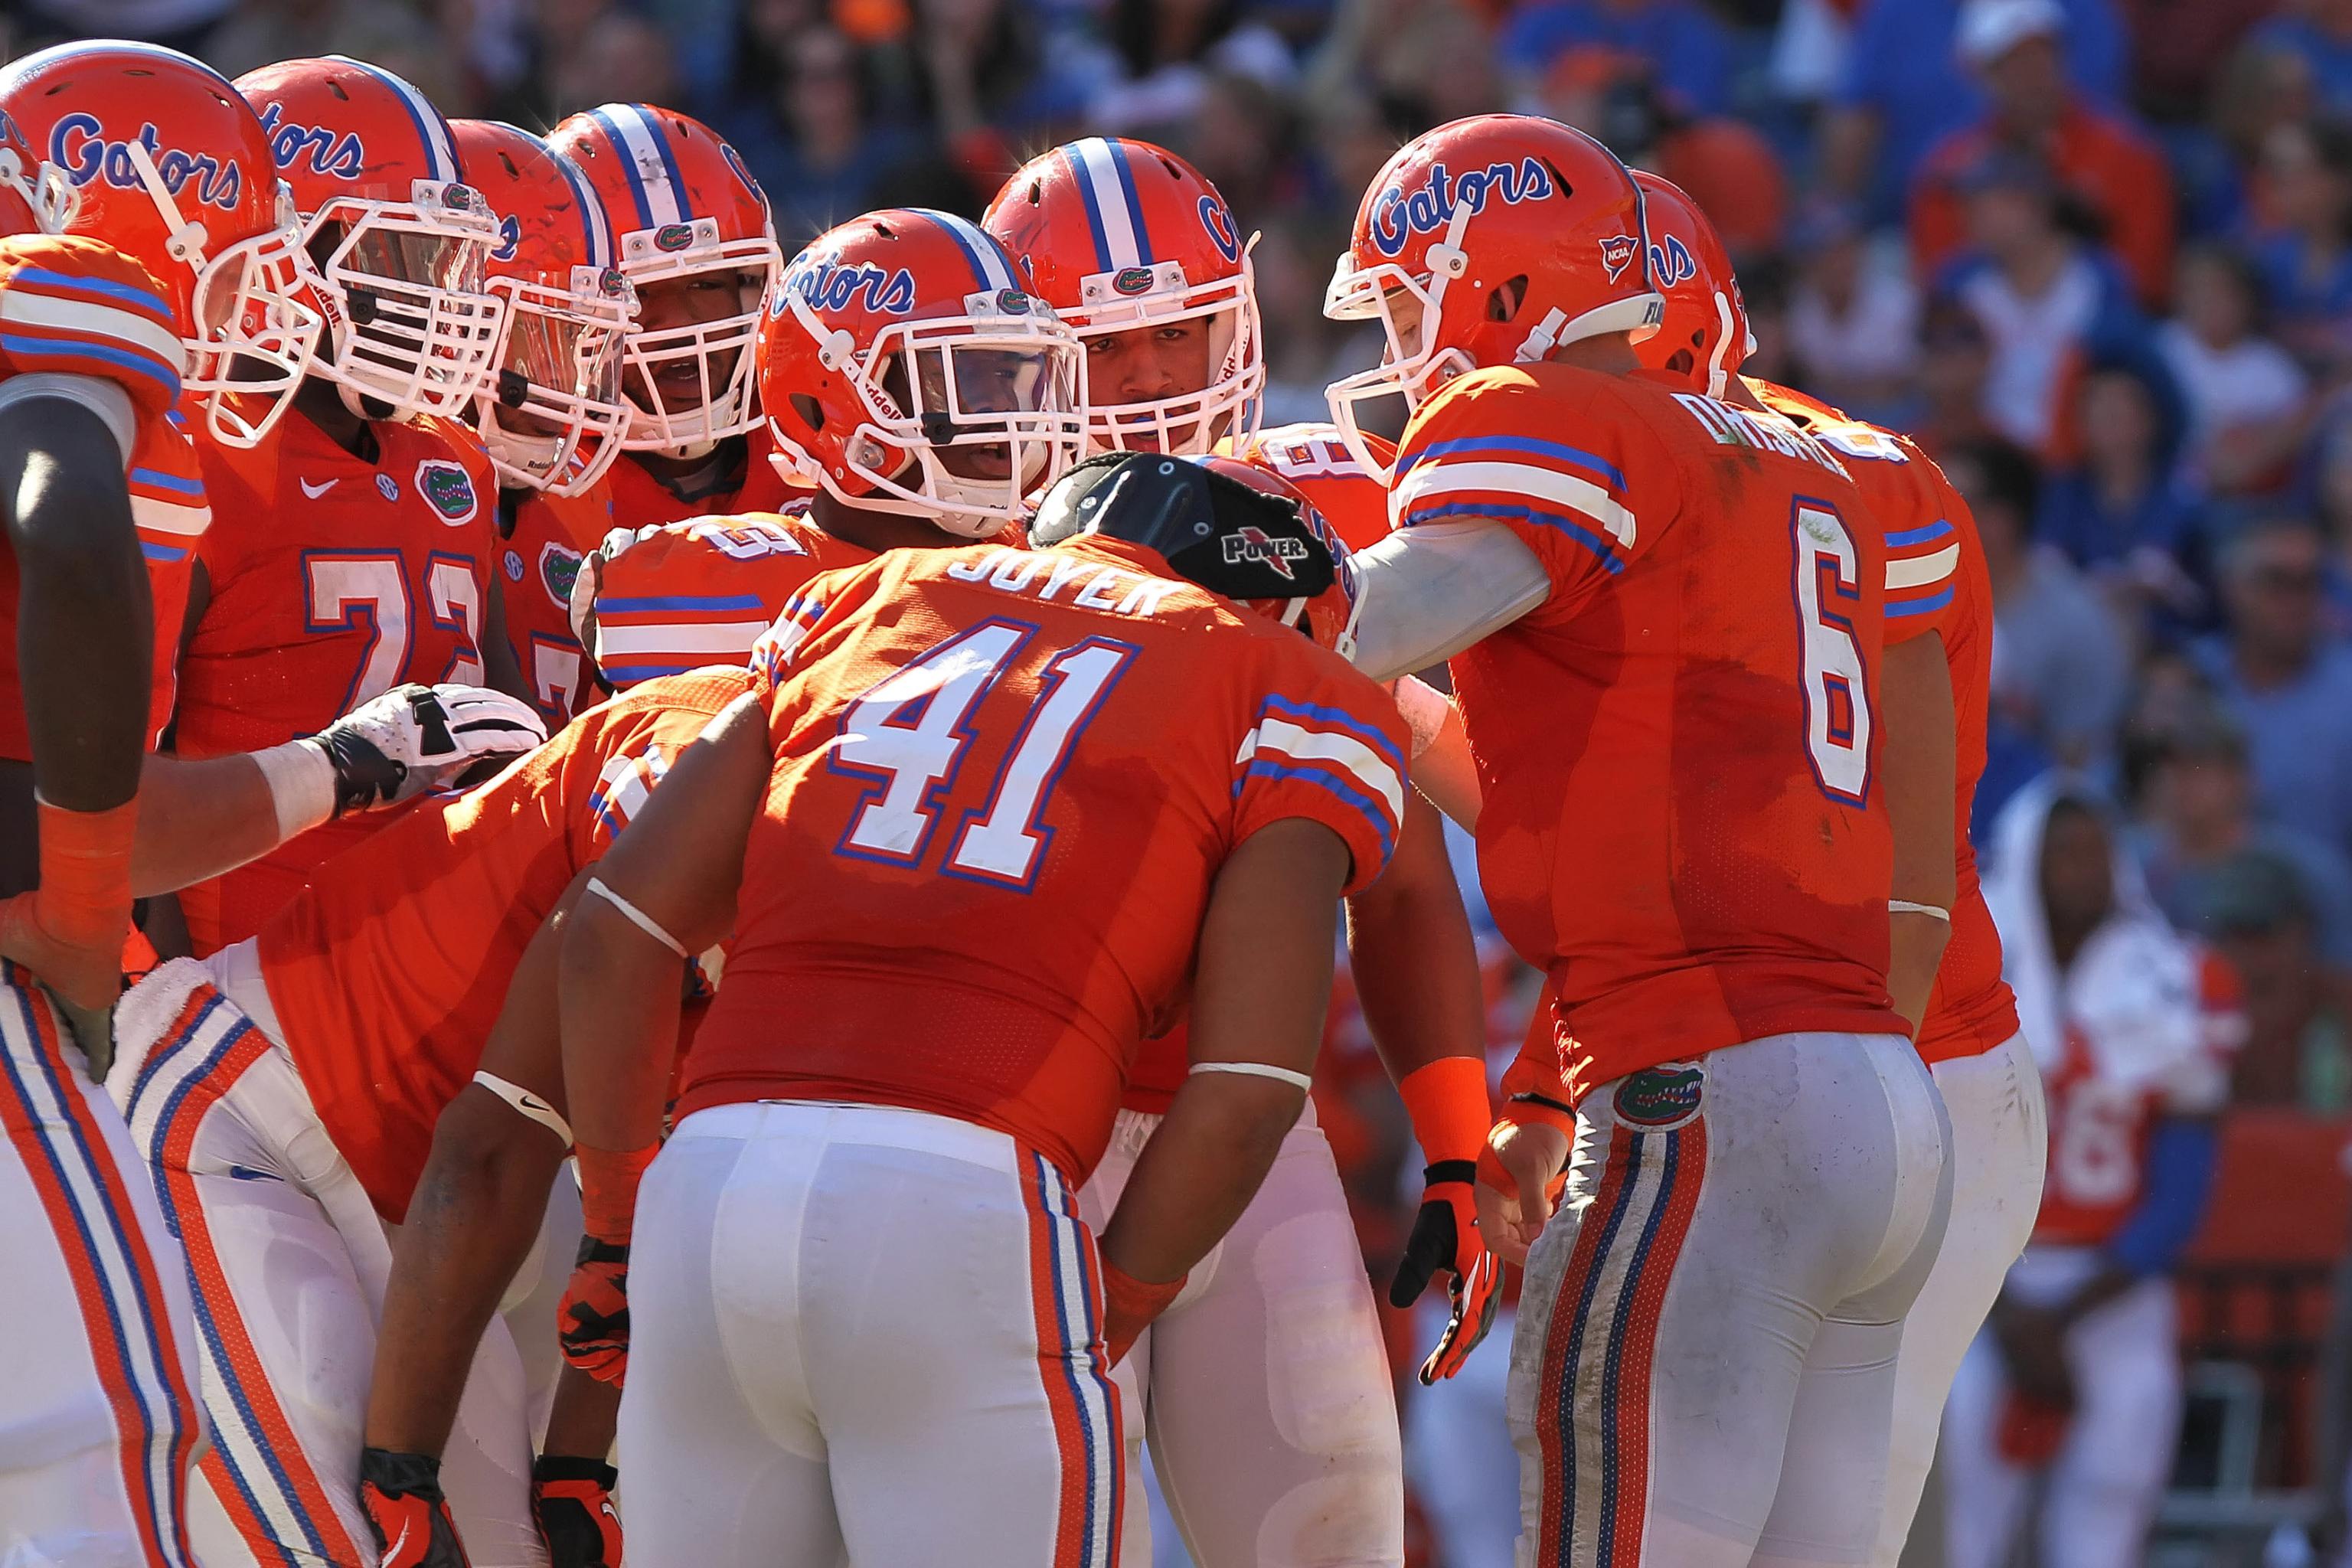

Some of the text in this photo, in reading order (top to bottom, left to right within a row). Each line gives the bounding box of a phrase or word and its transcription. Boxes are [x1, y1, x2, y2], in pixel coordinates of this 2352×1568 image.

[49, 113, 241, 211] Gators
[1373, 156, 1553, 257] Gators
[1607, 247, 1630, 262] NCAA
[947, 547, 1187, 616] JOYER
[1793, 499, 1872, 805] 6
[831, 620, 1135, 888] 41
